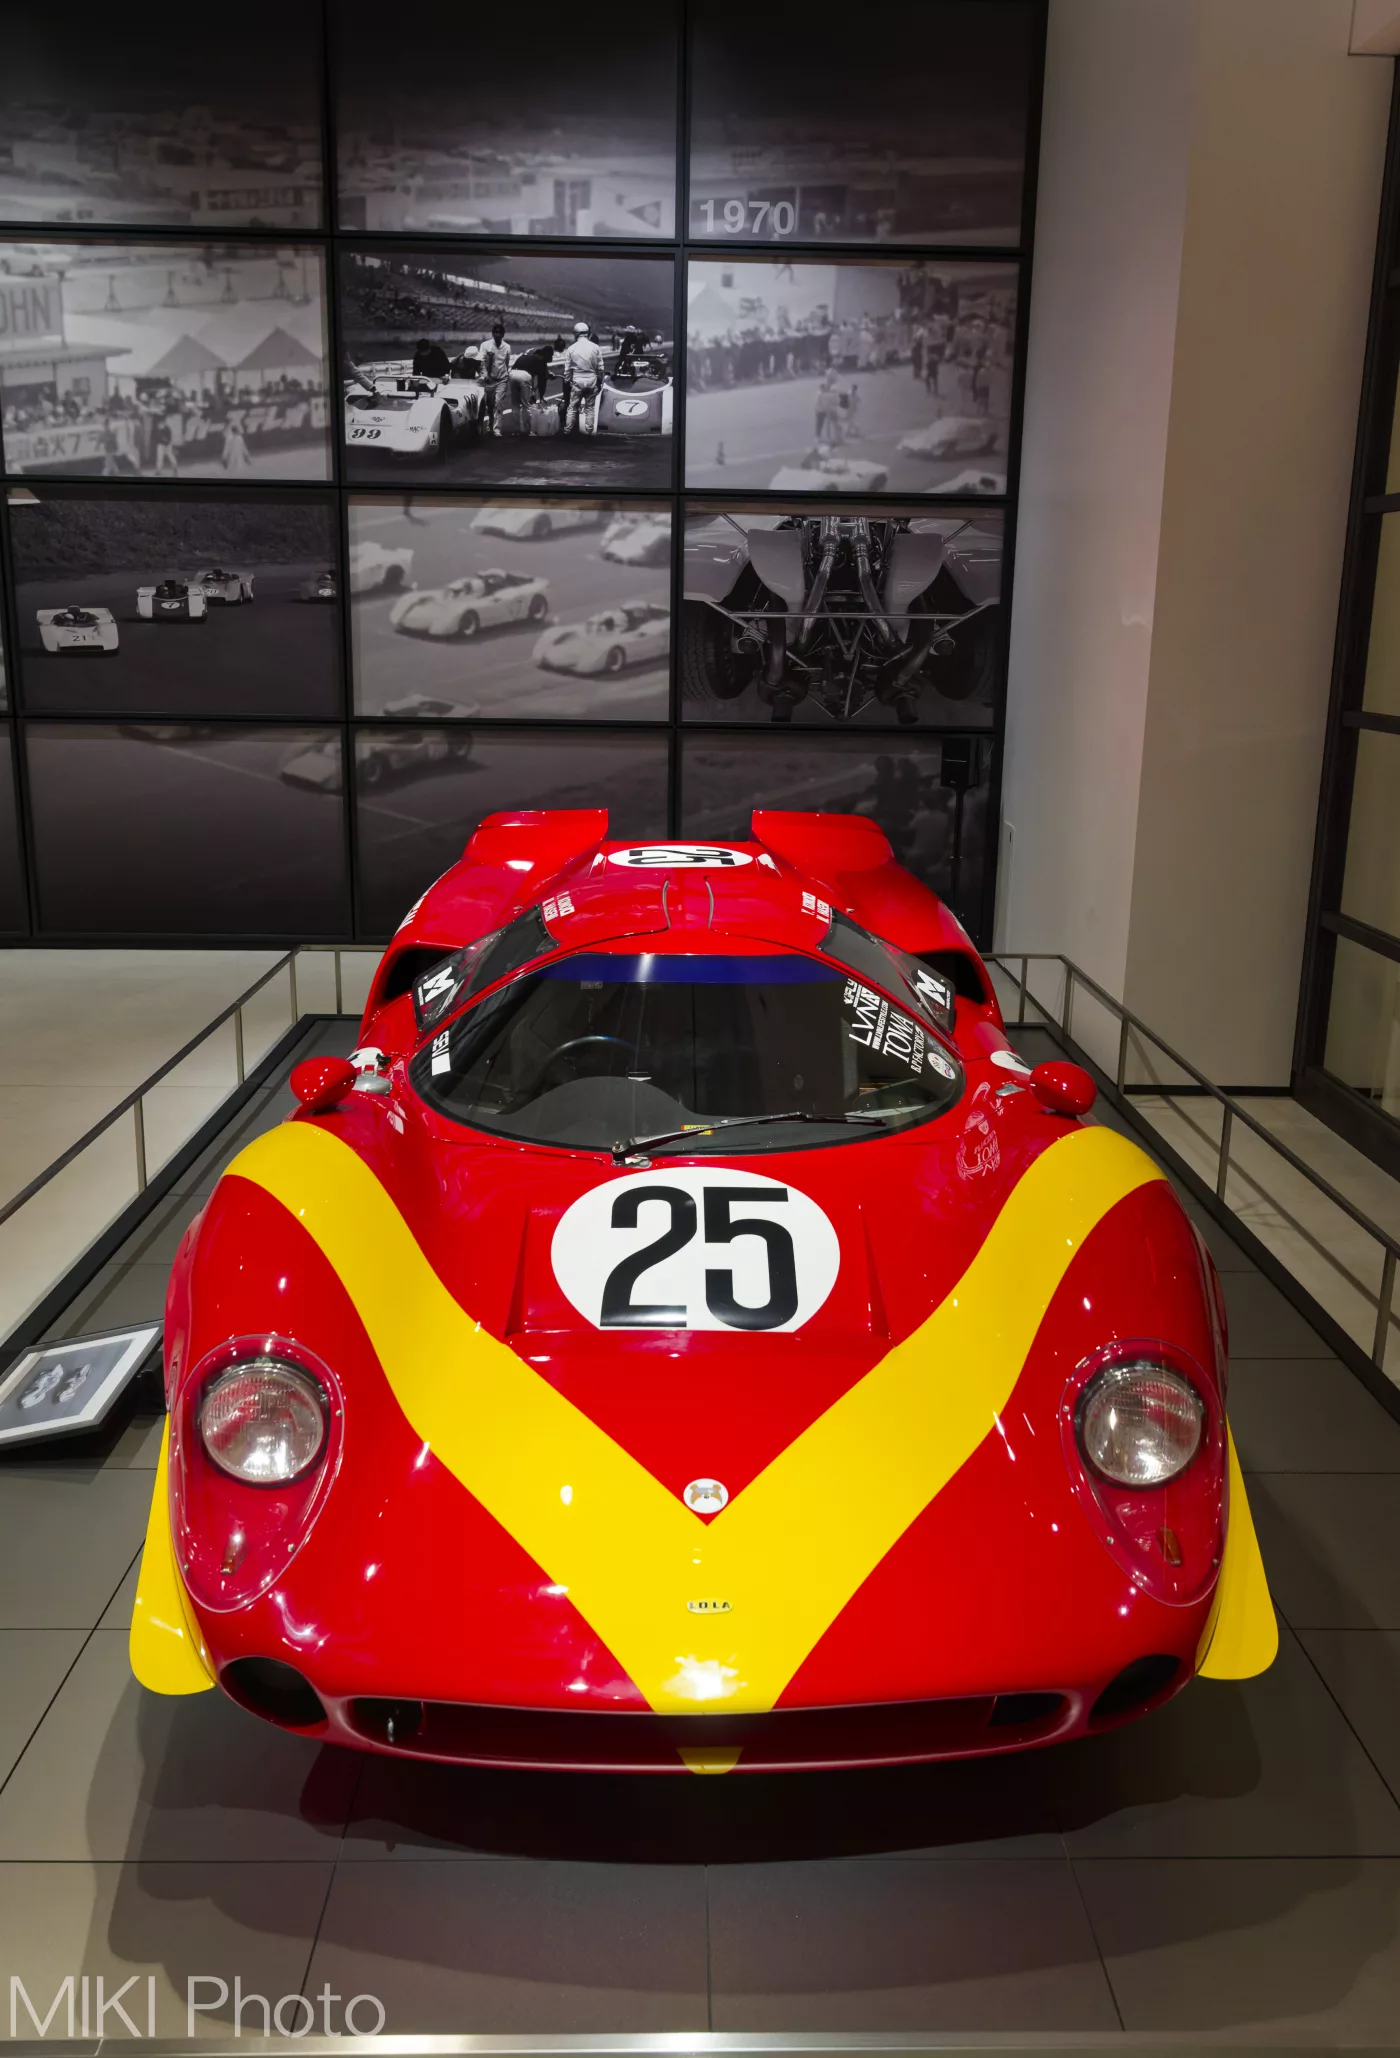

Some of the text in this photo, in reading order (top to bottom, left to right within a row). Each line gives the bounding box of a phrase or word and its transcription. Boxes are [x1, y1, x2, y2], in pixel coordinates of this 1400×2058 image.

[700, 200, 794, 234] 1970
[625, 402, 640, 413] 7
[351, 428, 381, 439] 99
[628, 849, 736, 865] 25
[882, 1011, 914, 1063] TOWA
[600, 1185, 798, 1330] 25
[688, 1601, 730, 1609] LOLA
